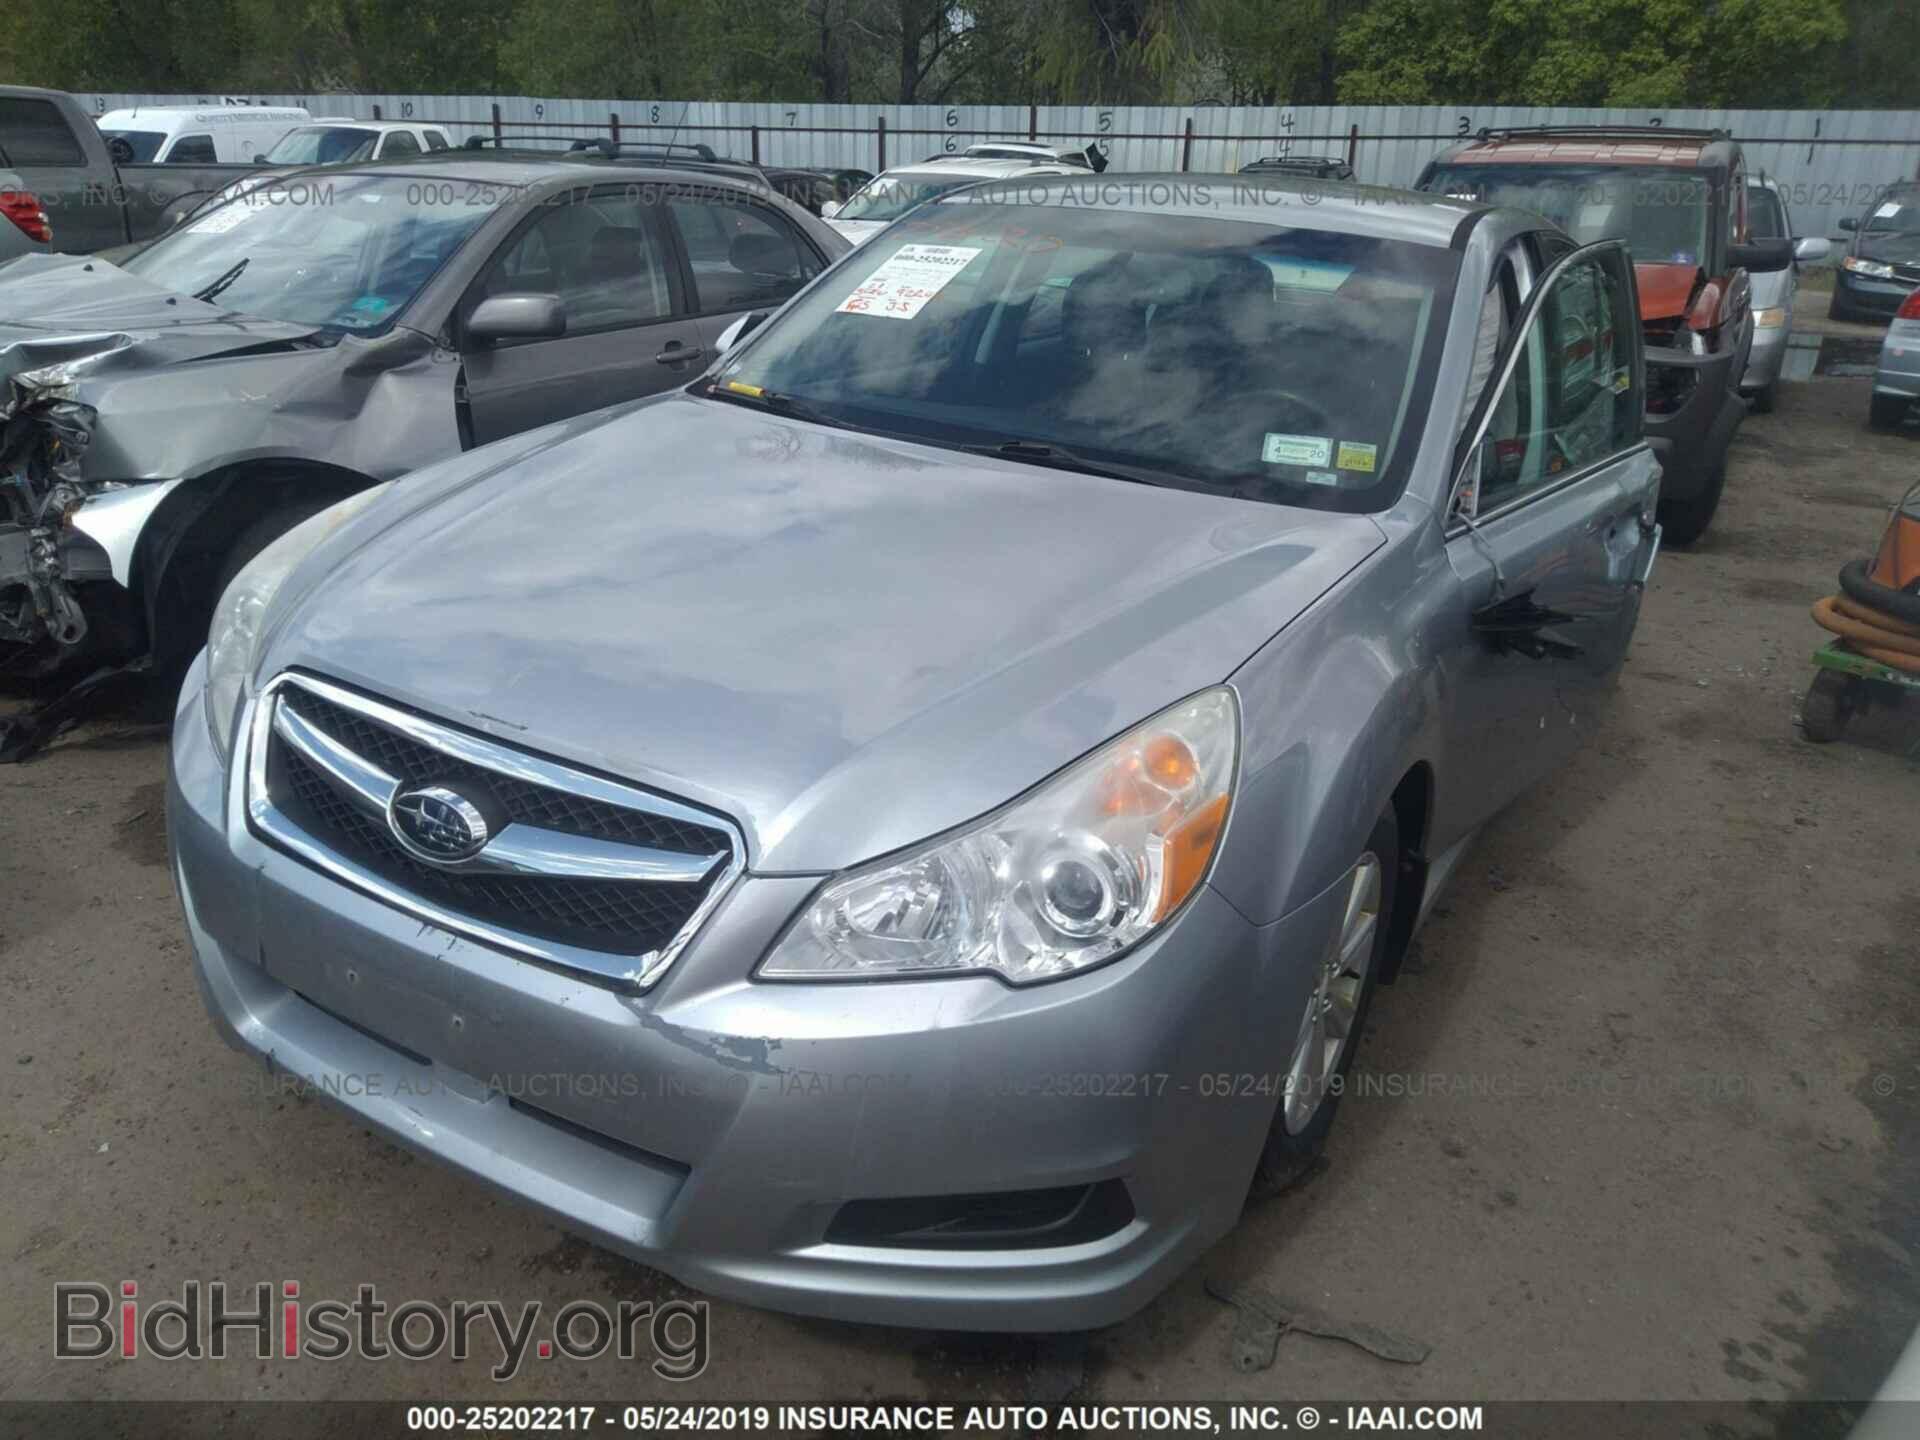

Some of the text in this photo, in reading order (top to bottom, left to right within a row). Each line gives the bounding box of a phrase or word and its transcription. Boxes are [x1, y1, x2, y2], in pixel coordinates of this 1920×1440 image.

[401, 102, 413, 118] 10
[535, 104, 544, 120] 9
[651, 105, 660, 123] 8
[946, 109, 959, 127] 6
[785, 112, 797, 127] 7
[1099, 111, 1113, 132] 5
[1281, 113, 1295, 134] 4
[1458, 116, 1471, 136] 3
[1813, 117, 1821, 138] 1
[944, 135, 957, 152] 6
